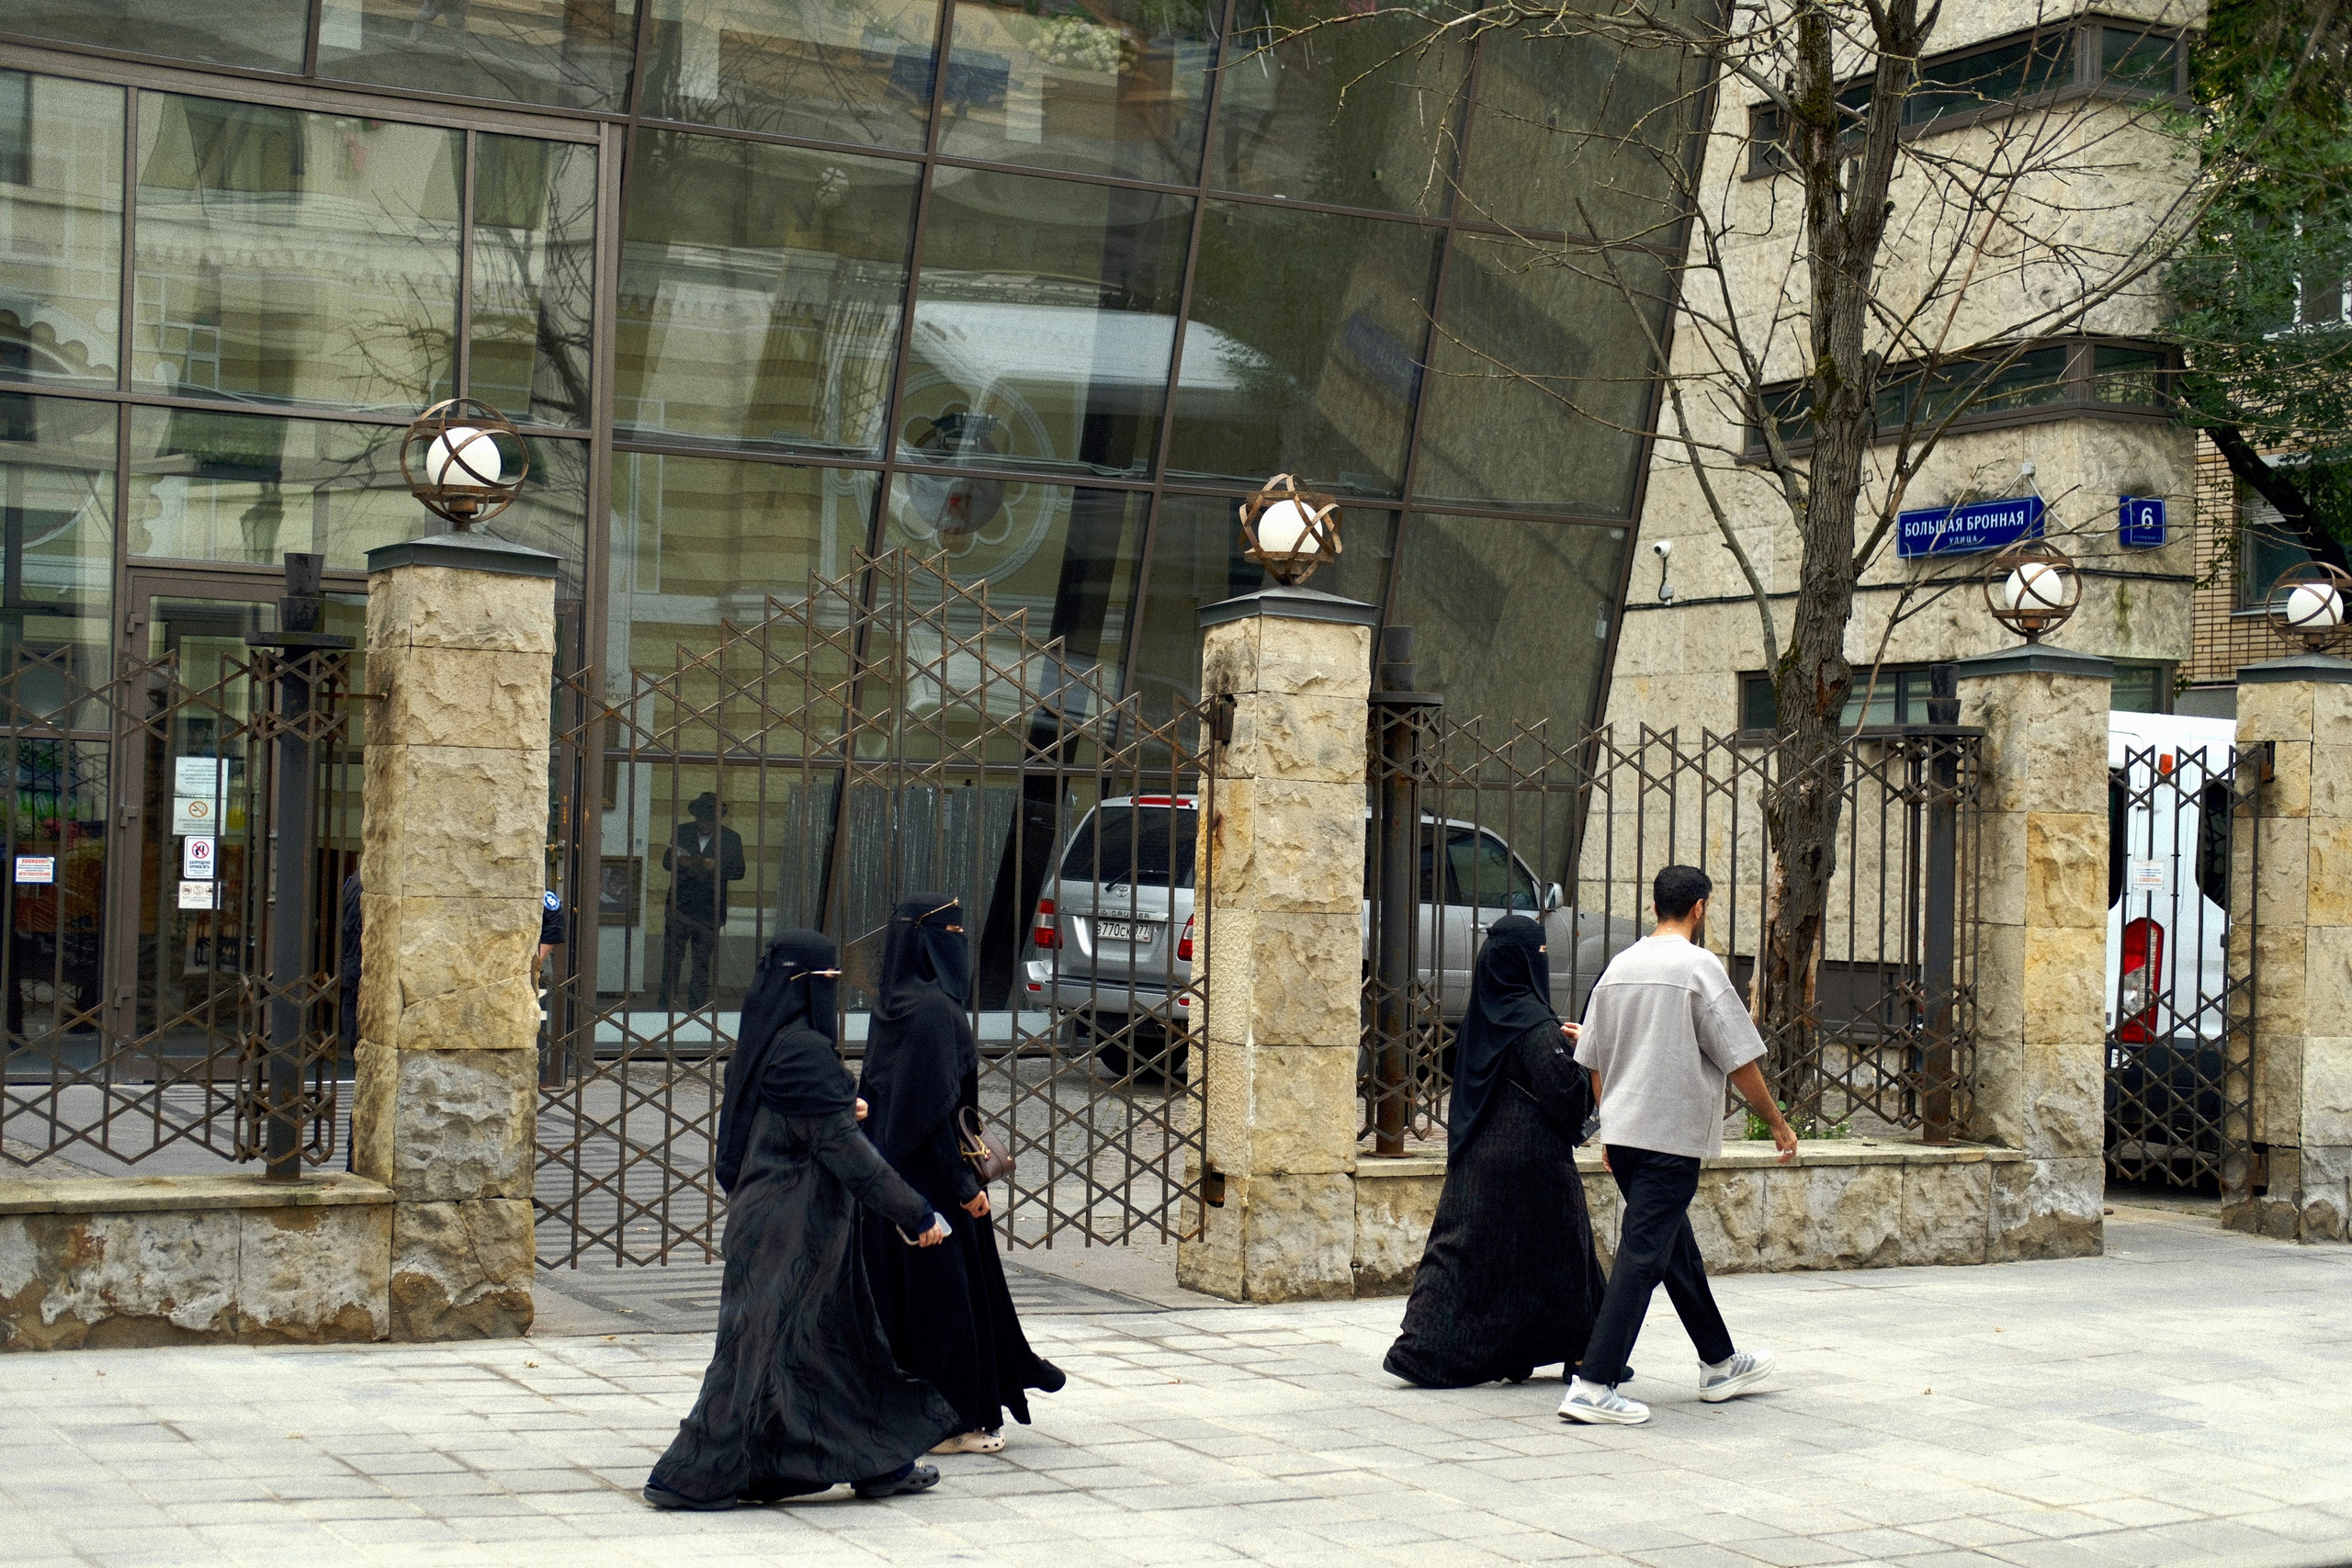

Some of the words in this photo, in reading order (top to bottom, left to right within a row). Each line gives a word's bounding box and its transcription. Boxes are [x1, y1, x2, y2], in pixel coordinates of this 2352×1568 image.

[1905, 517, 1963, 537] БОЛЬШАЯ
[1966, 510, 2024, 531] БРОННАЯ
[2141, 506, 2154, 530] 6
[1949, 534, 1978, 545] УЛИЦА
[1111, 910, 1150, 919] CRUER
